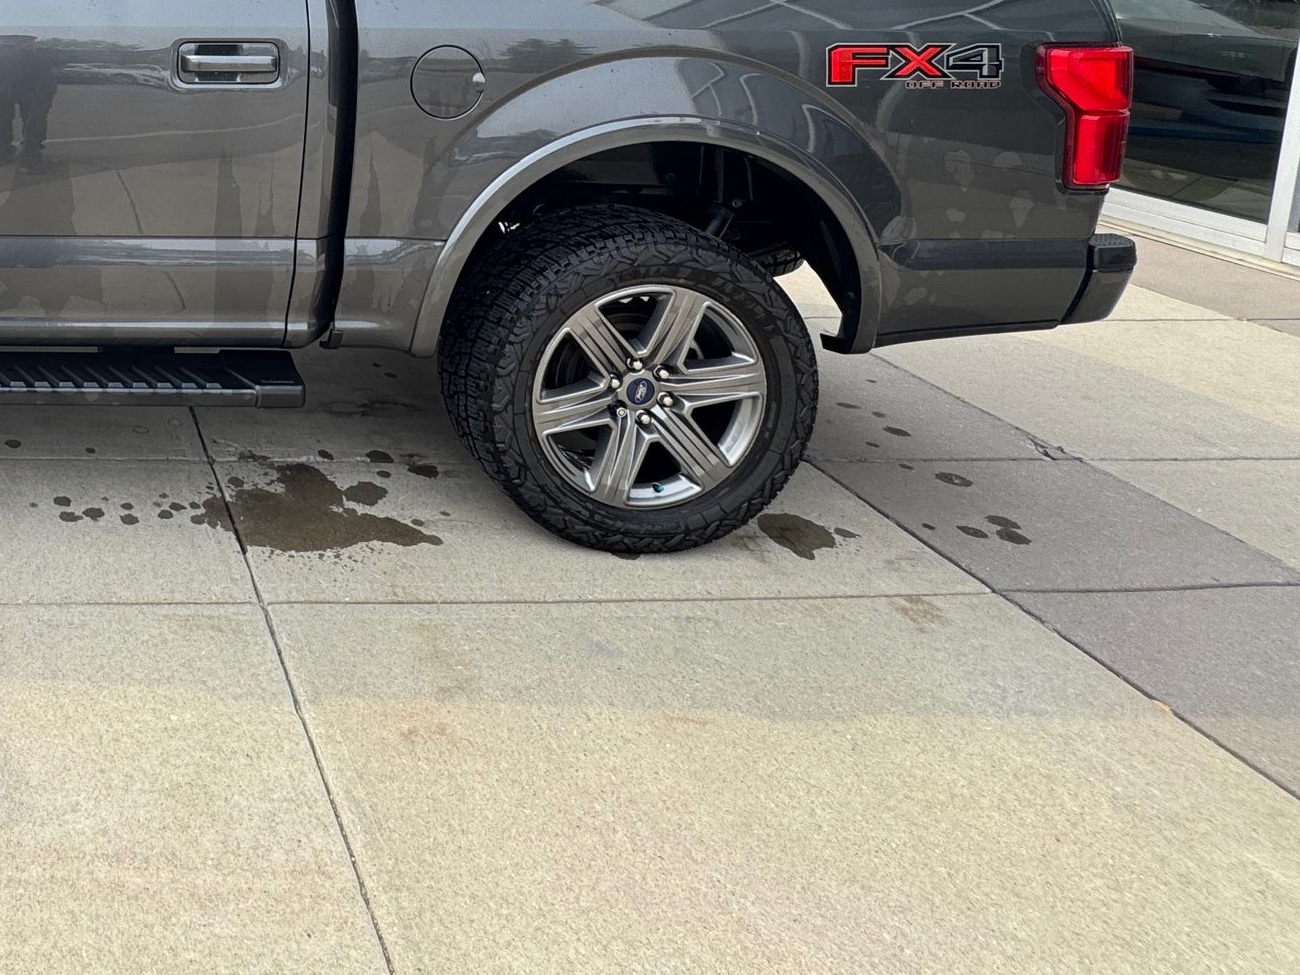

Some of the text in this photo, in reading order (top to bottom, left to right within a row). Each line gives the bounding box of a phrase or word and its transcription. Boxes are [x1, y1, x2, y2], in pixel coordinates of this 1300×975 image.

[826, 43, 1004, 87] FX4
[905, 80, 1002, 90] OFF ROAD
